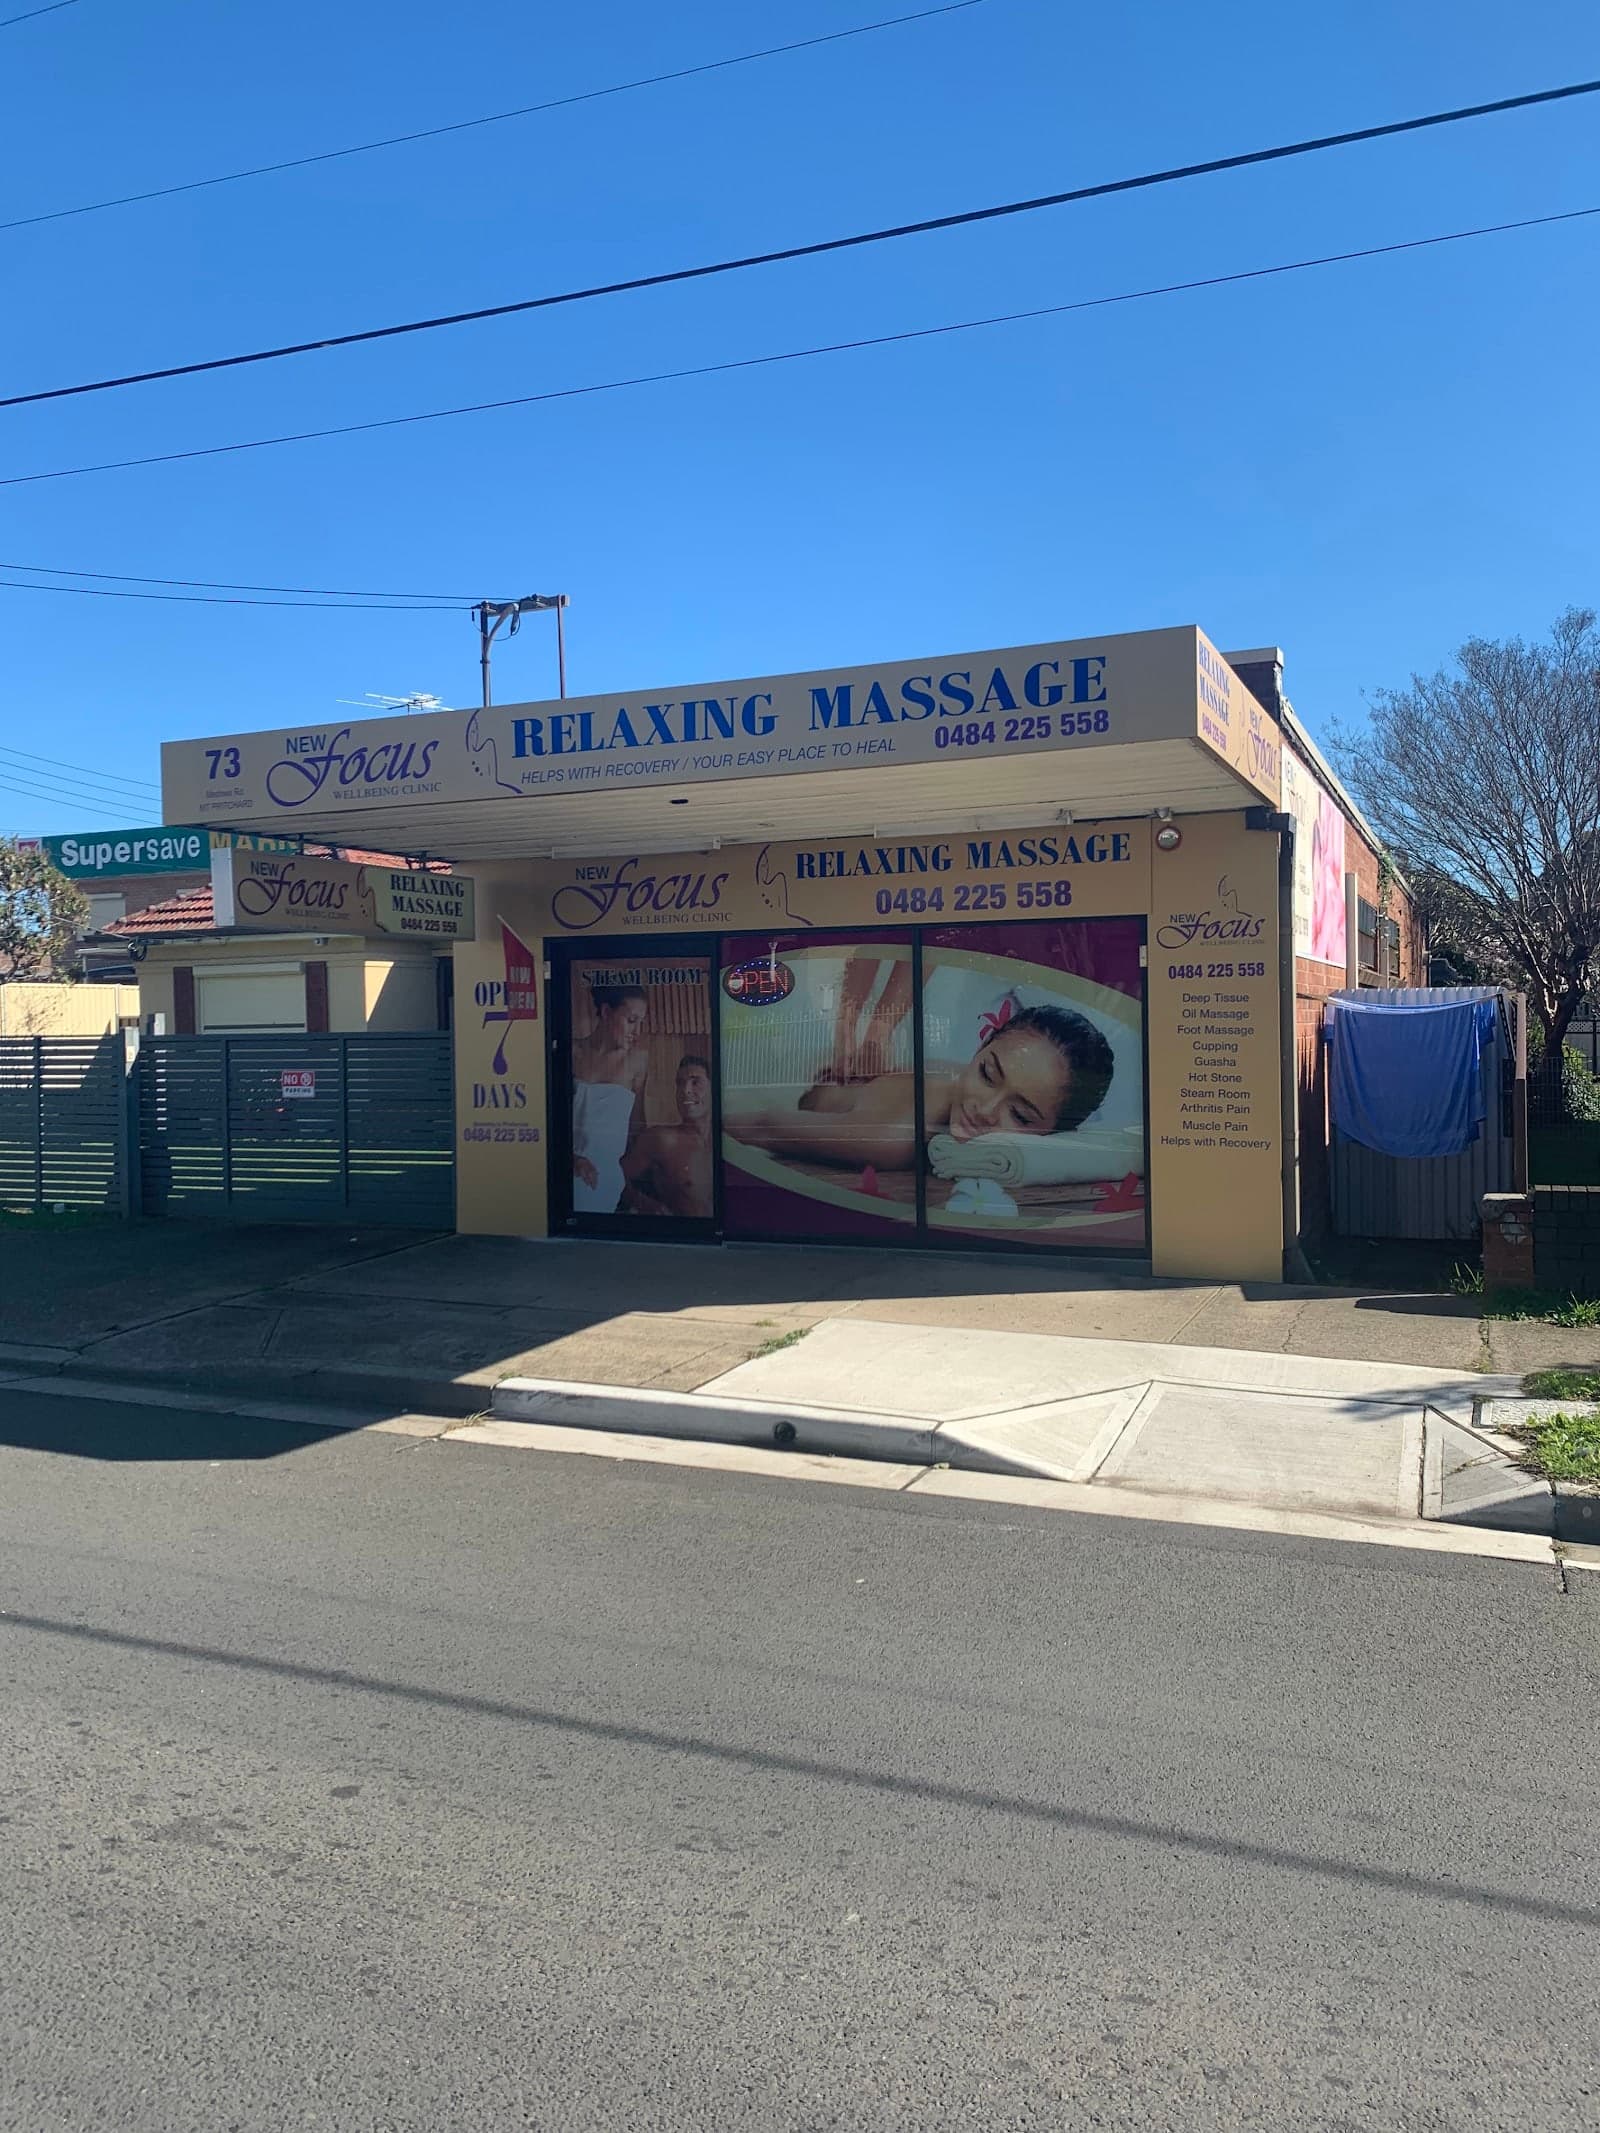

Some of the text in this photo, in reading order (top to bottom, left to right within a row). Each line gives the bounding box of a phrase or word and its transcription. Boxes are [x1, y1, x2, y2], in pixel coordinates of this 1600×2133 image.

[511, 656, 1107, 759] RELAXING MASSAGE
[1200, 673, 1230, 727] MASSAGE
[934, 709, 1110, 749] 0484 225 558
[286, 734, 327, 755] NEW
[205, 747, 241, 779] 73
[521, 768, 564, 785] HELPS
[568, 765, 602, 780] WITH
[605, 759, 680, 777] RECOVERY
[693, 754, 733, 770] YOUR
[737, 750, 774, 767] EASY
[777, 744, 827, 762] PLACE
[831, 742, 852, 757] TO
[856, 738, 897, 755] HEAL
[332, 782, 443, 801] WELLBEING CLINIC
[60, 835, 201, 871] Supersave
[796, 833, 1131, 879] RELAXING MASSAGE
[250, 861, 280, 877] NEW
[575, 866, 610, 880] NEW
[390, 874, 465, 898] RELAXING
[875, 880, 1072, 914] 0484 225 558
[392, 895, 463, 918] MASSAGE
[401, 918, 457, 933] 0484 225 558
[622, 912, 733, 926] WELLBEING CLINIC
[1169, 913, 1196, 923] NEW
[582, 967, 702, 987] STEAM ROOM
[1168, 962, 1265, 979] 0484 225 558
[729, 970, 789, 994] OPEN
[475, 981, 509, 1007] OP
[1182, 992, 1250, 1006] Deep Tissue
[1182, 1008, 1250, 1021] Oil Massage
[1177, 1025, 1254, 1037] Foot Massage
[1192, 1040, 1238, 1053] Cupping
[1194, 1056, 1237, 1067] Guasha
[283, 1074, 298, 1085] NO
[1188, 1072, 1242, 1083] Hot Stone
[473, 1083, 527, 1108] DAYS
[1180, 1089, 1250, 1099] Steam Room
[1180, 1103, 1250, 1114] Arthritis Pain
[1182, 1120, 1248, 1132] Muscle Pain
[1160, 1135, 1272, 1151] Helps with Recovery
